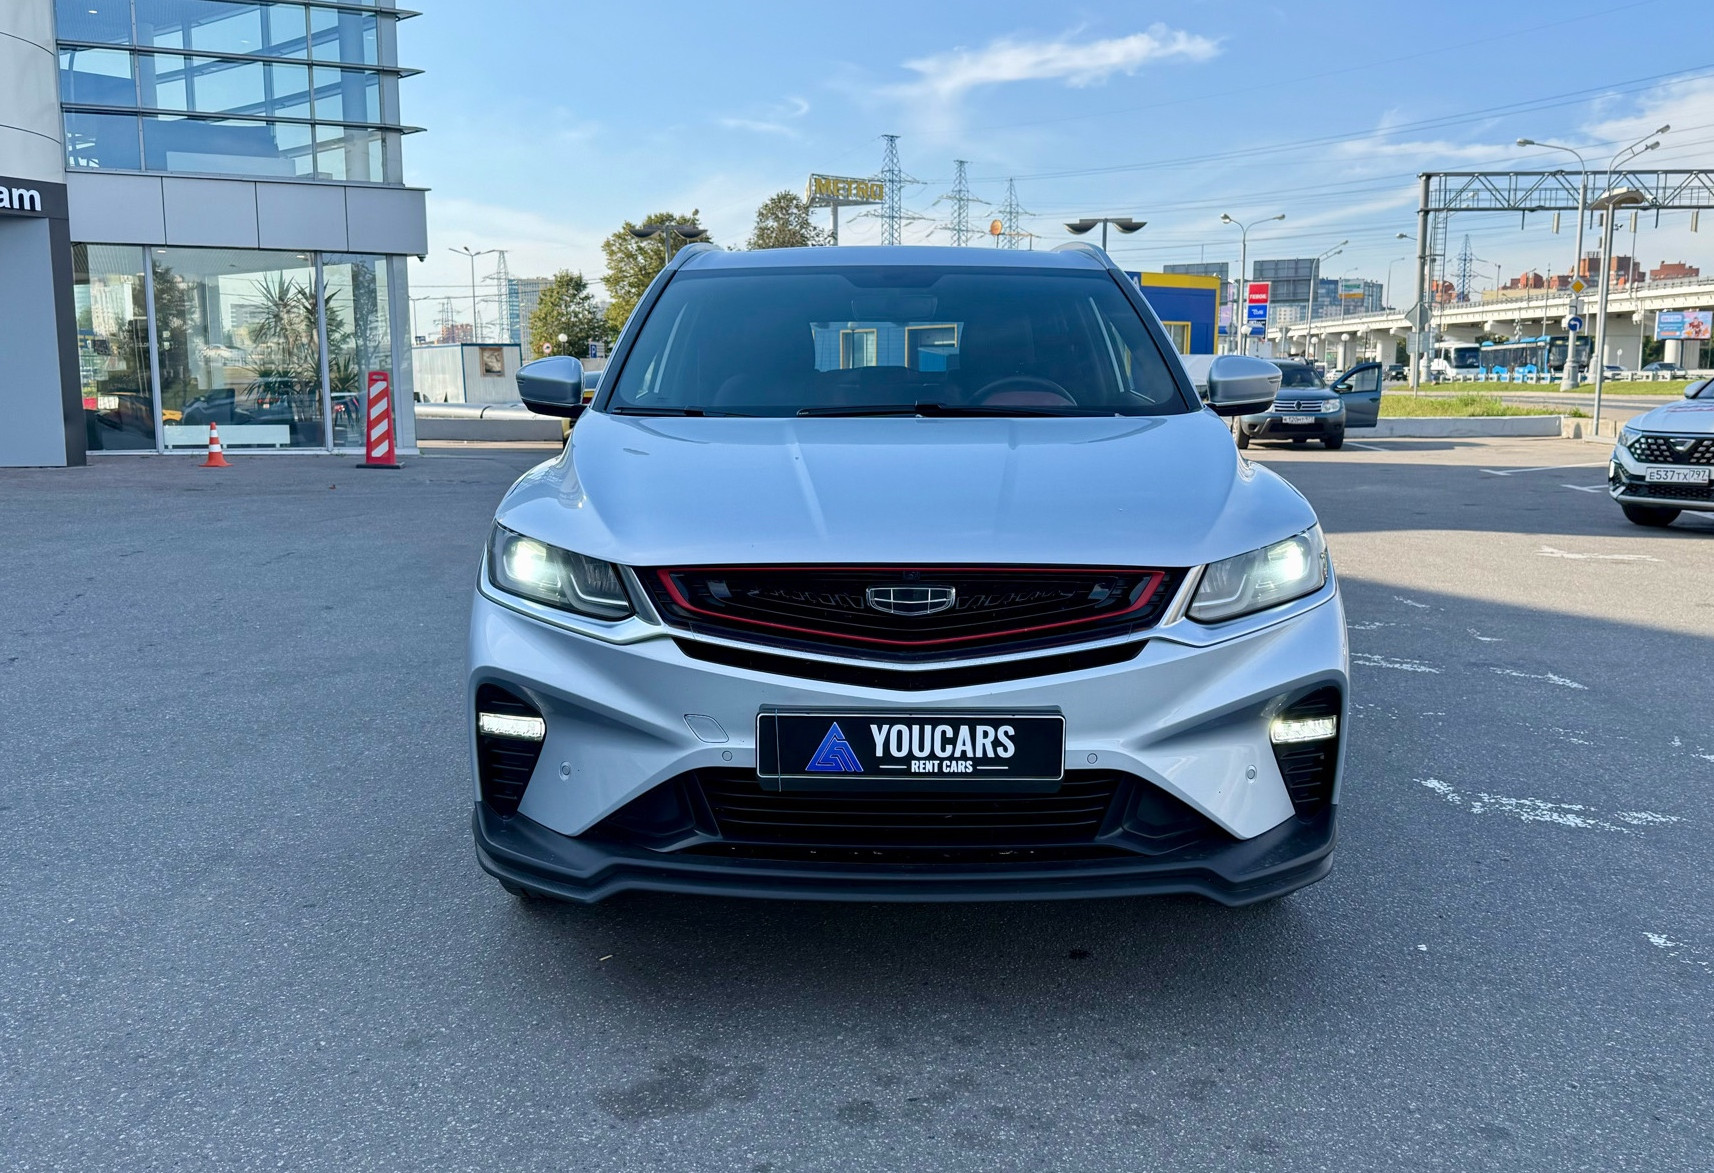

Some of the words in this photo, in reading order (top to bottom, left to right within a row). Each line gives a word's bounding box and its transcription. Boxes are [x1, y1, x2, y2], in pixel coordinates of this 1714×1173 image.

[815, 178, 884, 201] METRO
[869, 724, 1016, 759] YOUCARS
[911, 760, 940, 774] RENT
[942, 760, 973, 774] CARS
